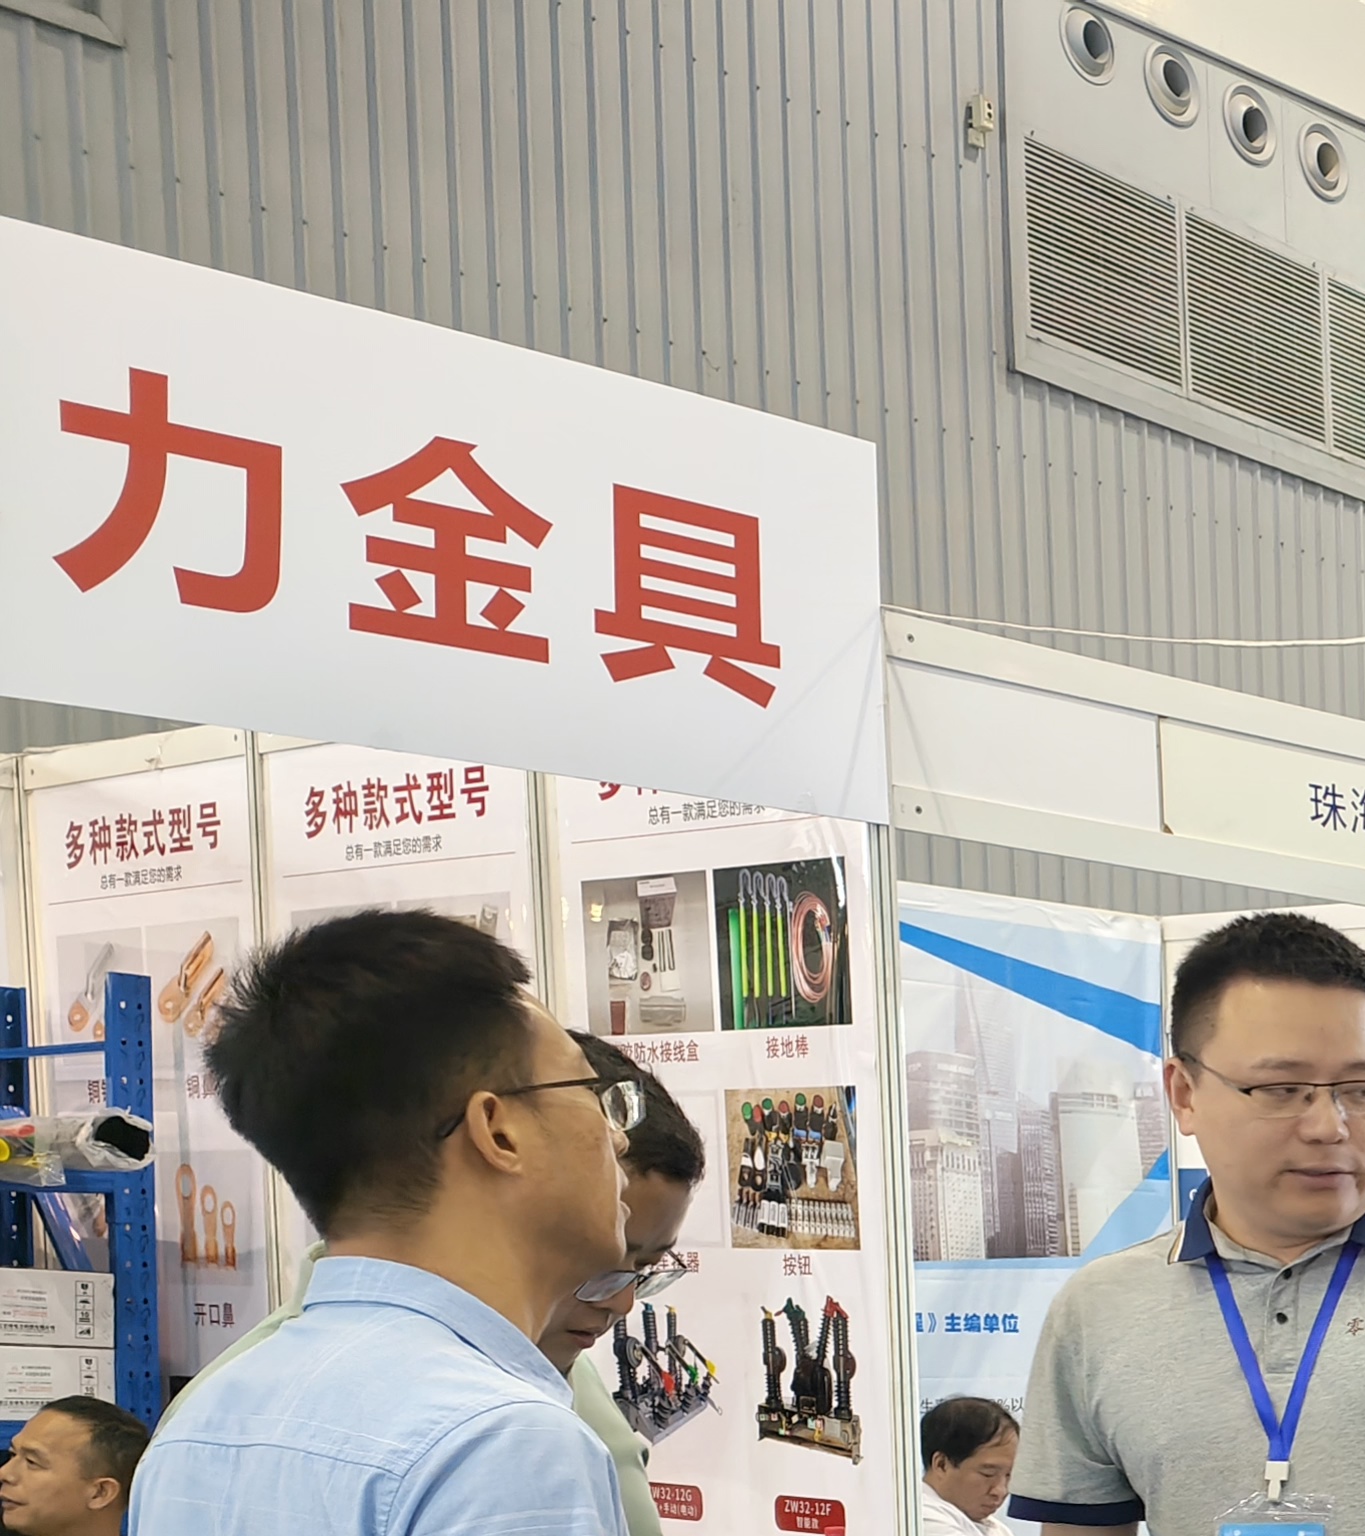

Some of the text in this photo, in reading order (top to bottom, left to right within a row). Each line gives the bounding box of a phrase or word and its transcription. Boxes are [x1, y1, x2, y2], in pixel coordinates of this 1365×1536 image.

[52, 366, 782, 709] 力金具
[303, 765, 490, 839] 多种款式型号
[65, 801, 221, 869] 多种款式型号
[345, 834, 443, 861] 总有一款满足您的需求
[99, 865, 183, 891] 总有一款满足您的需求
[765, 1034, 809, 1059] 接地棒
[782, 1254, 812, 1276] 按钮
[193, 1301, 236, 1328] 开口鼻
[650, 1486, 693, 1502] W32-12G
[783, 1499, 832, 1517] ZW32-12F
